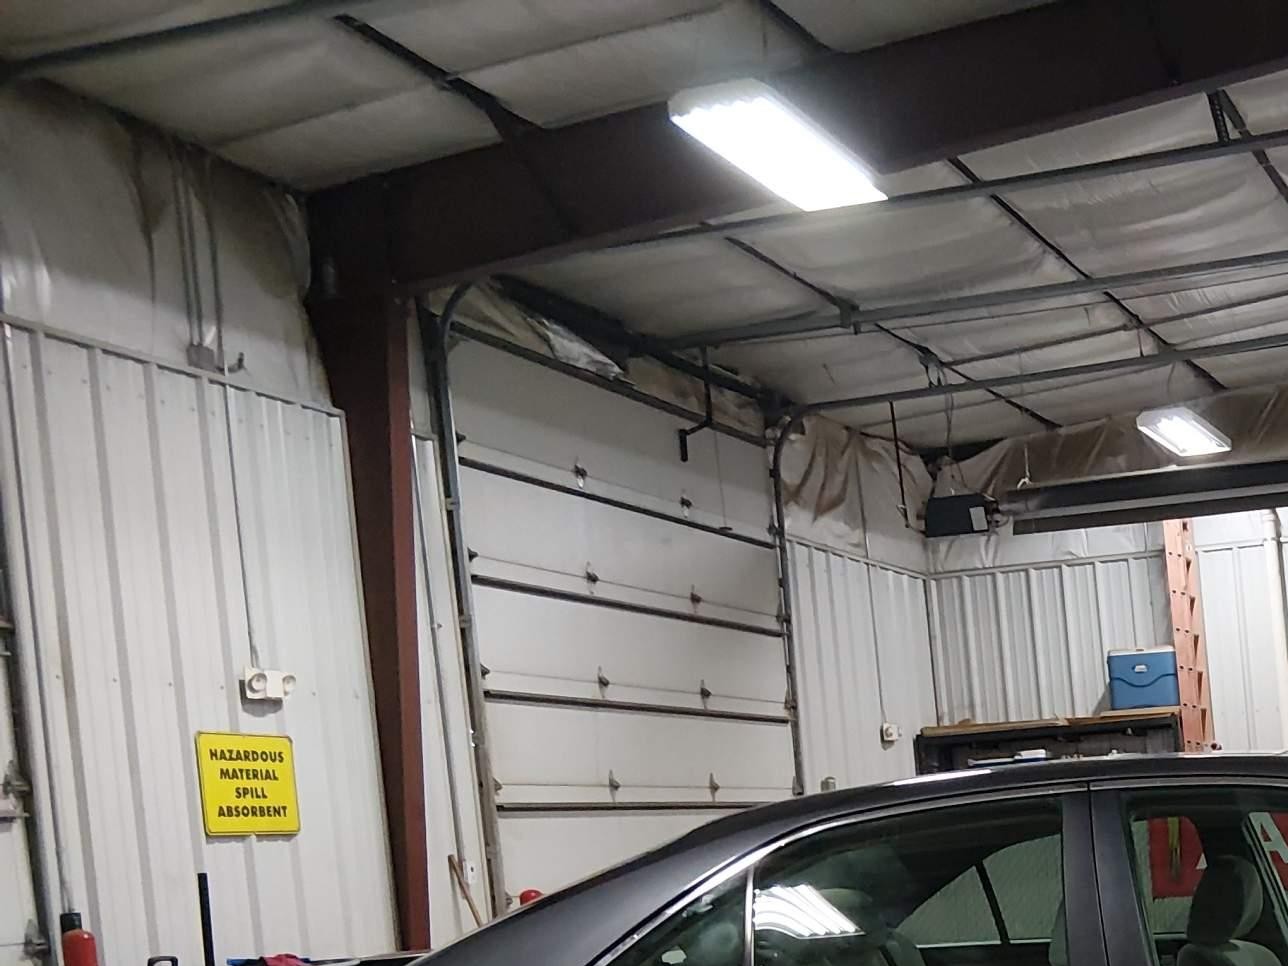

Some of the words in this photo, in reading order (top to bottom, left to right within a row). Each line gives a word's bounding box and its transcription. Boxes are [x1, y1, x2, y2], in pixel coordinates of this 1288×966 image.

[209, 748, 285, 763] HAZARDOUS
[219, 768, 279, 781] MATERIAL
[235, 787, 268, 799] SPILL
[217, 805, 288, 818] ABSORBENT
